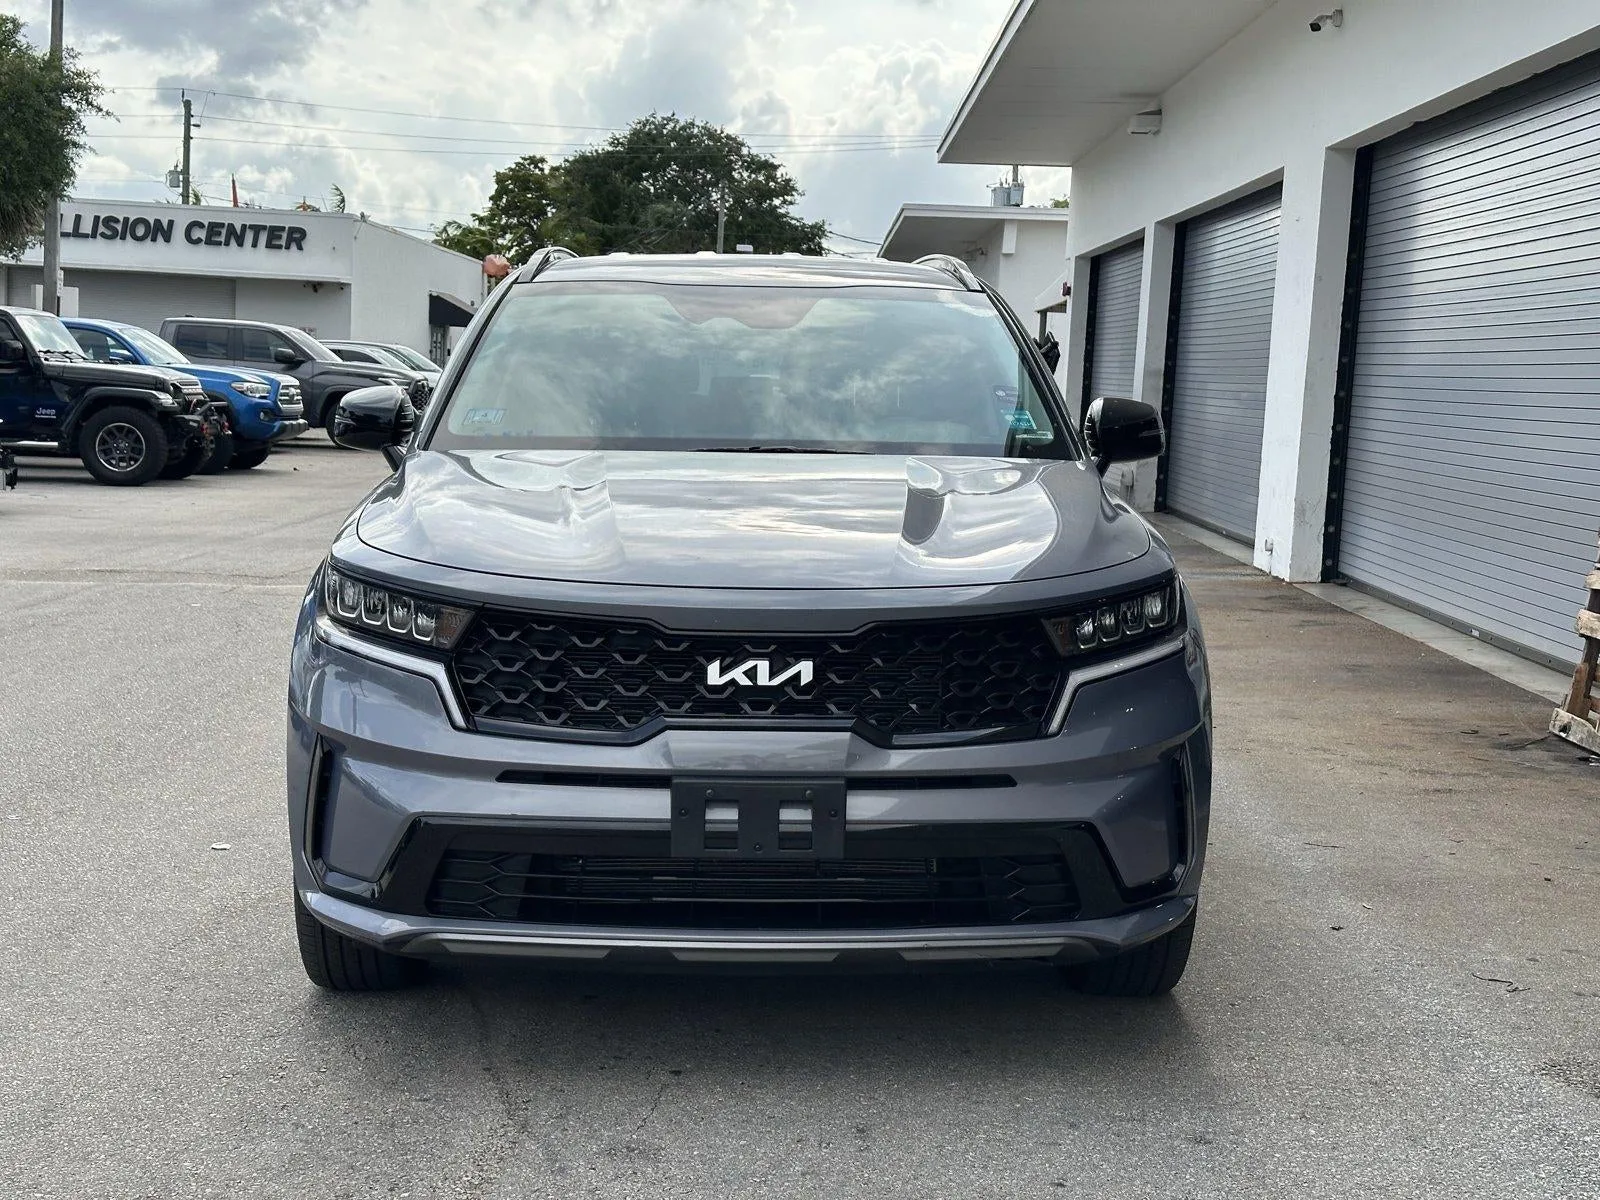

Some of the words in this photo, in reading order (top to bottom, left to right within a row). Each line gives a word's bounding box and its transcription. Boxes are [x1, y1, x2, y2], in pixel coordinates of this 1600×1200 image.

[184, 220, 307, 251] CENTER
[36, 407, 56, 416] Jeep
[707, 659, 814, 687] KIA
